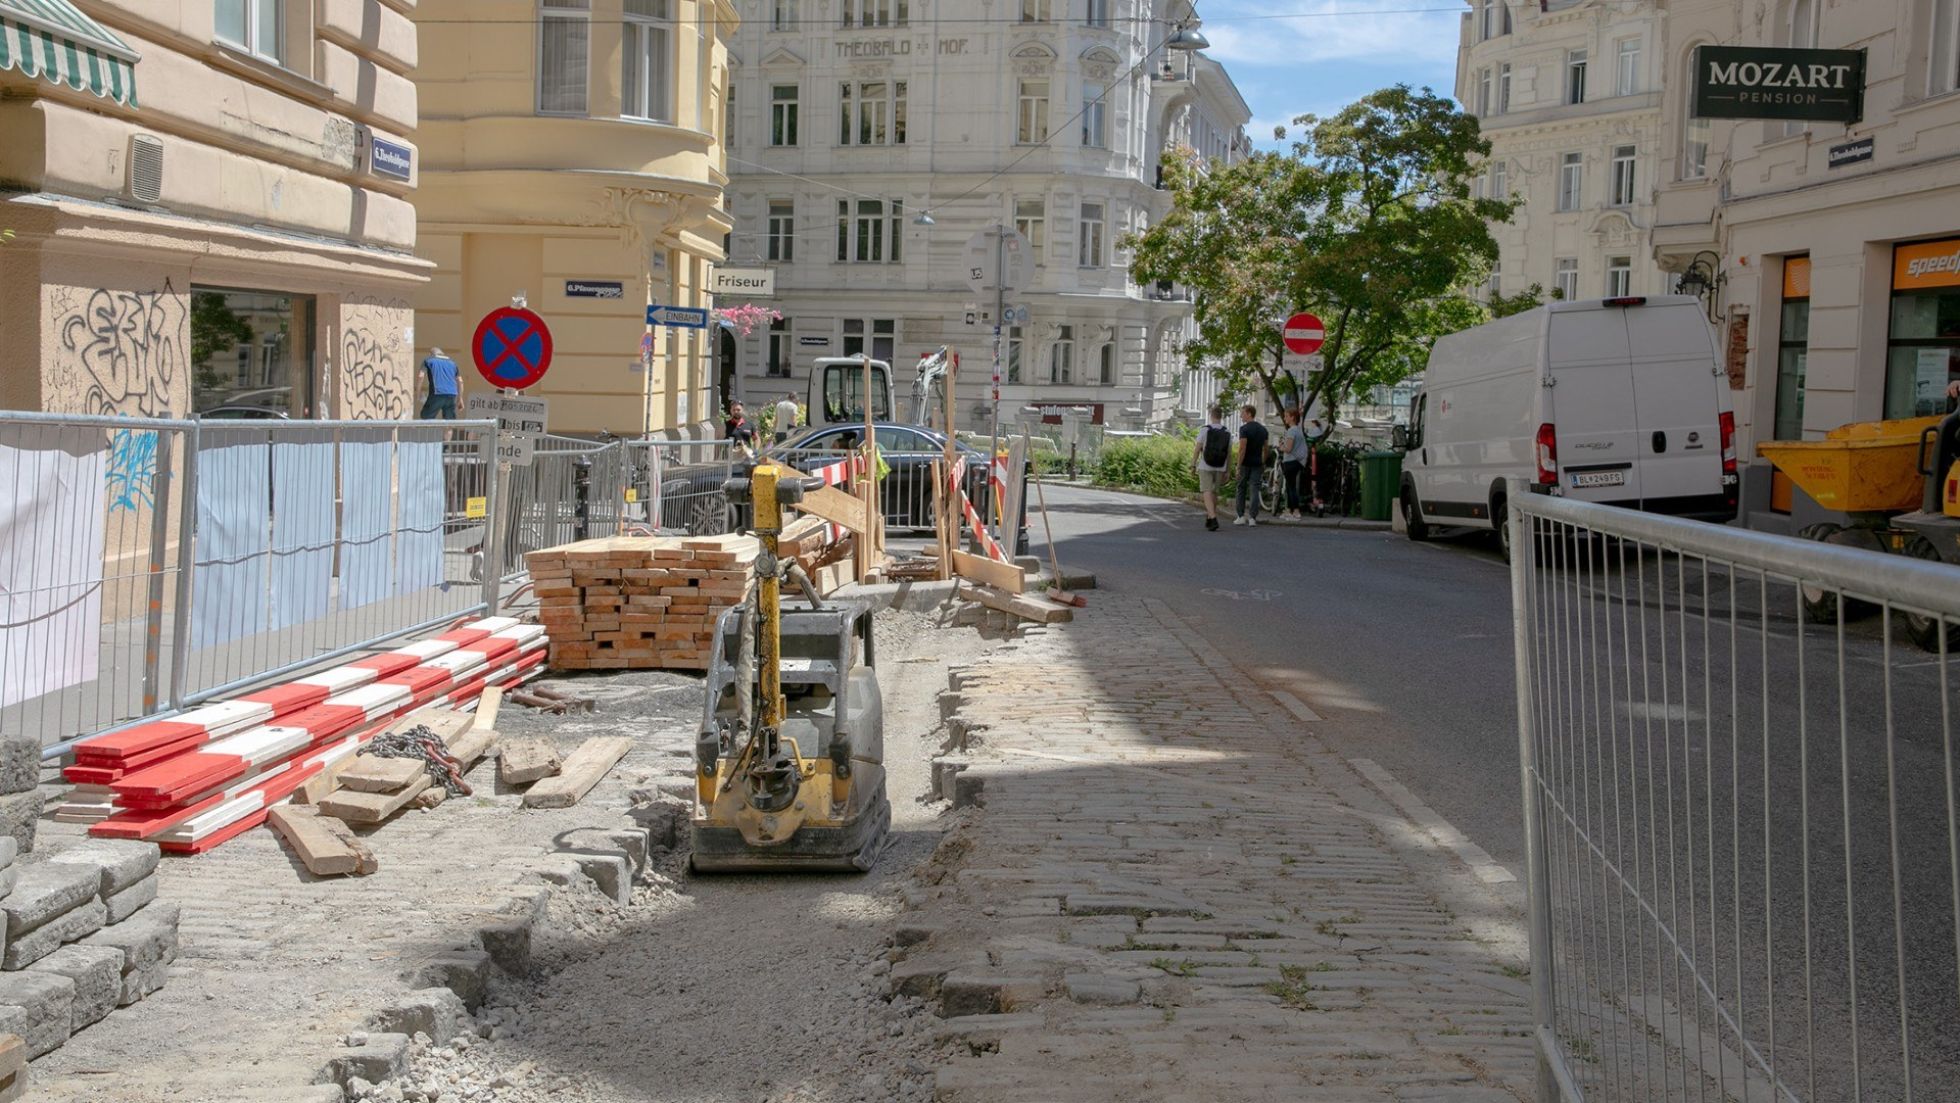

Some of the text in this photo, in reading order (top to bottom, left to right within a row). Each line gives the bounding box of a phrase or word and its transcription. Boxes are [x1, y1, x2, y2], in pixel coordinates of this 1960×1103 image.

[835, 40, 911, 57] THEOBALD
[1708, 61, 1850, 89] MOZART
[1739, 91, 1816, 105] PENSION
[1908, 249, 1960, 278] speed
[717, 275, 767, 288] Friseur
[665, 311, 701, 323] EINBAHN
[470, 397, 486, 410] gilt
[487, 400, 499, 410] ab
[506, 420, 521, 431] bis
[496, 444, 522, 458] nde
